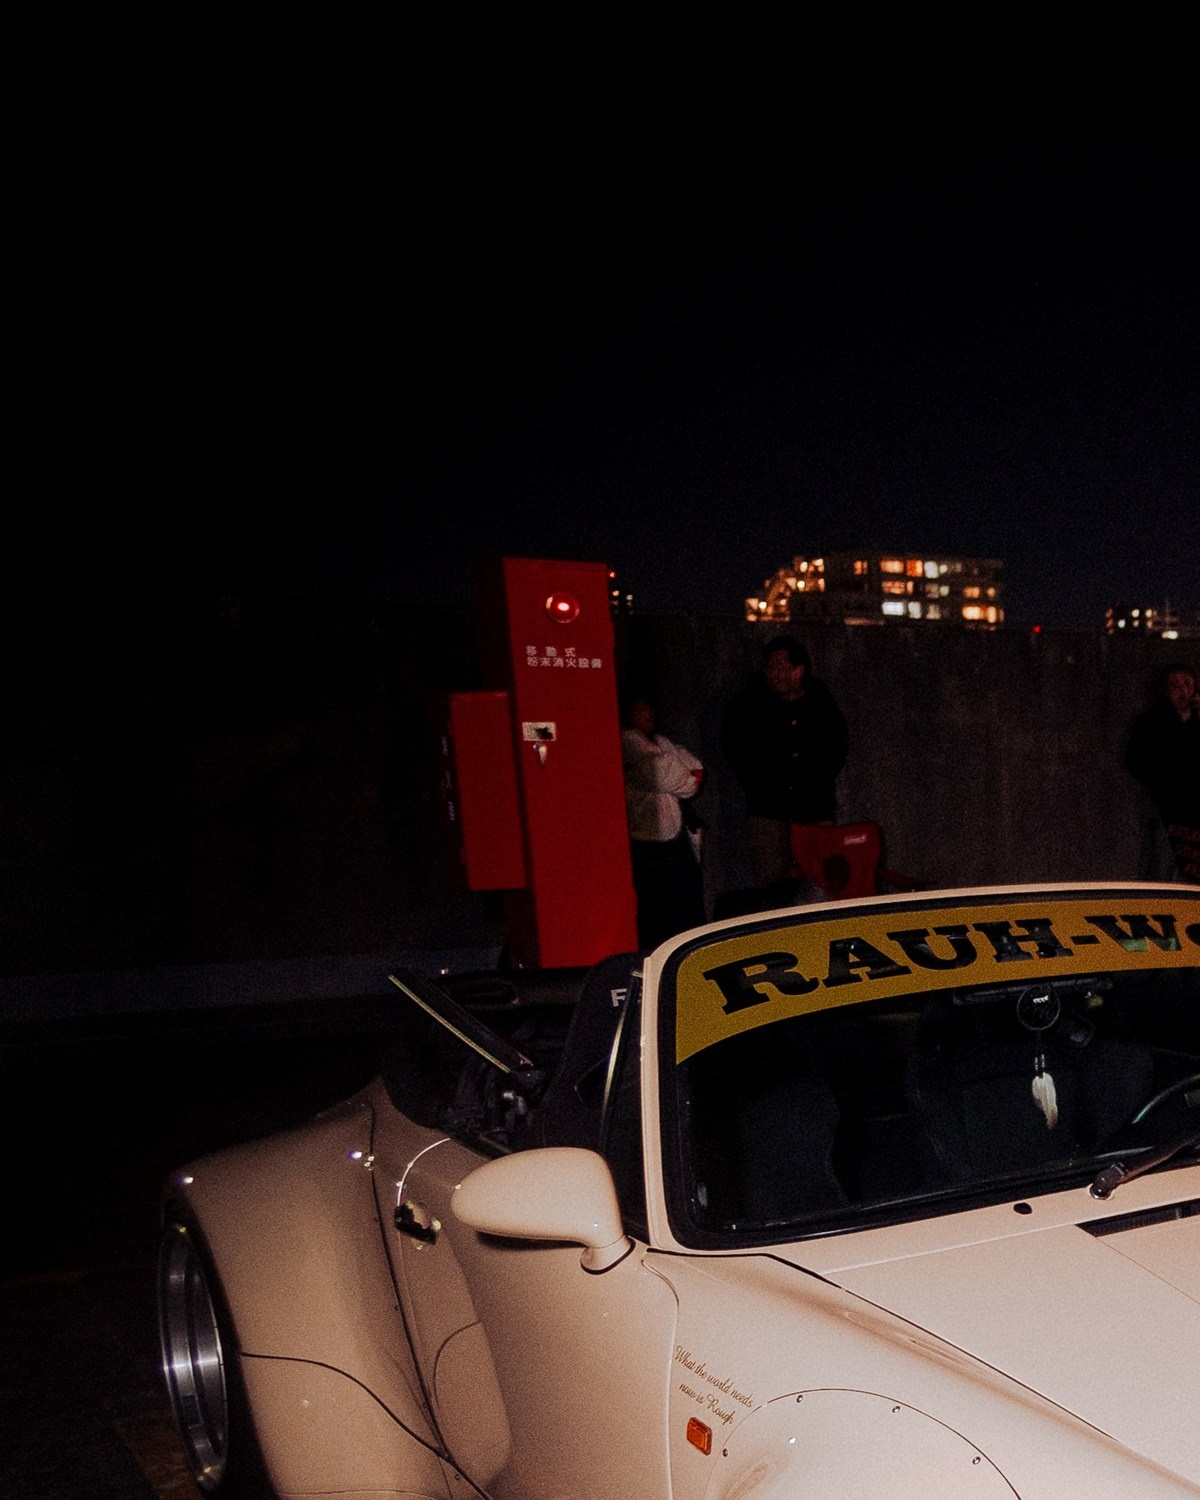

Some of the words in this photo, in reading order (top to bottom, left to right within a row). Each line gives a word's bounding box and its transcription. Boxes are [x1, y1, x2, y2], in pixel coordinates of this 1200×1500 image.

[674, 1345, 696, 1370] What
[695, 1363, 708, 1379] the
[707, 1378, 734, 1394] world
[730, 1393, 754, 1408] needs
[679, 1383, 697, 1398] now
[696, 1391, 706, 1404] is
[706, 1394, 736, 1426] Rough
